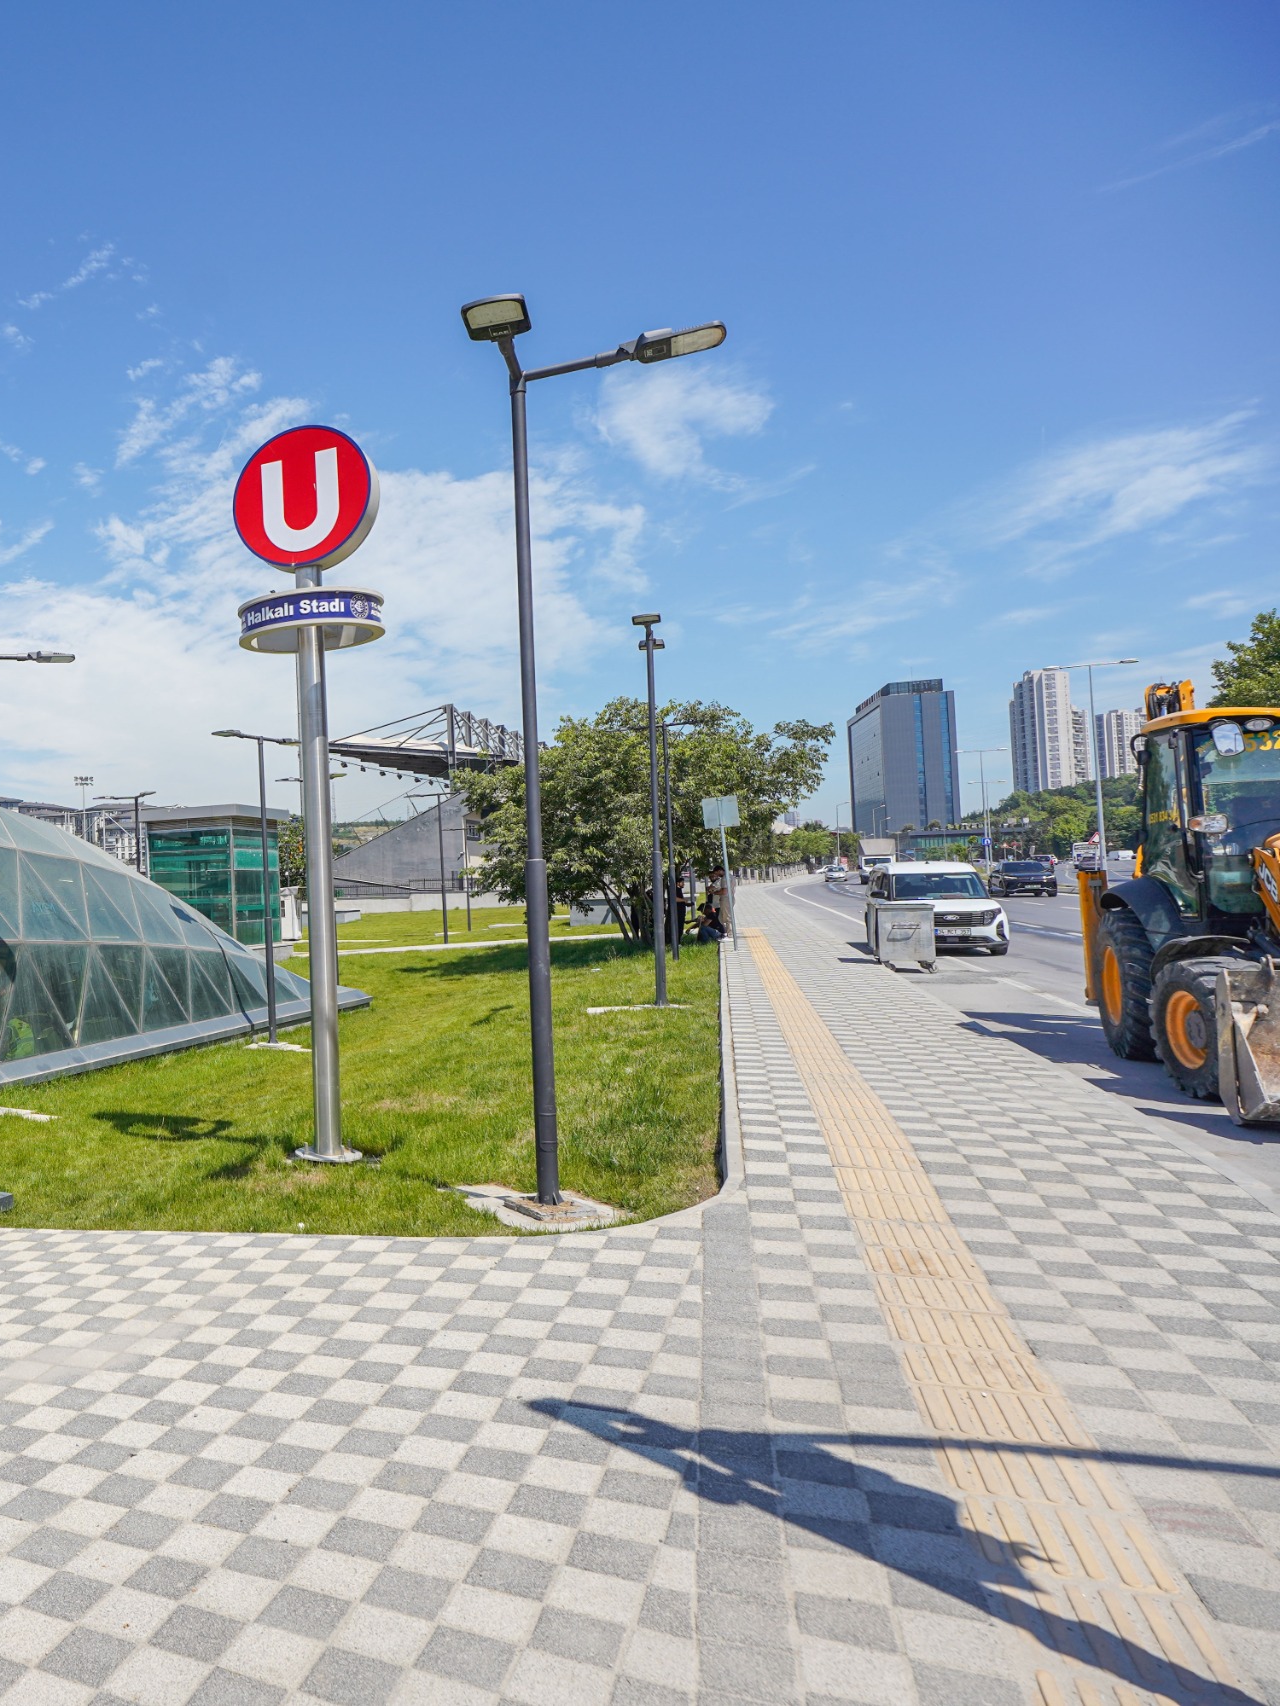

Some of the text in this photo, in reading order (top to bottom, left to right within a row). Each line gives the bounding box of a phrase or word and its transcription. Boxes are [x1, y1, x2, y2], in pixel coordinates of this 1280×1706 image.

[261, 447, 340, 552] U
[247, 603, 294, 626] Halkalı
[299, 598, 345, 614] Stadı
[1259, 863, 1278, 903] JCB
